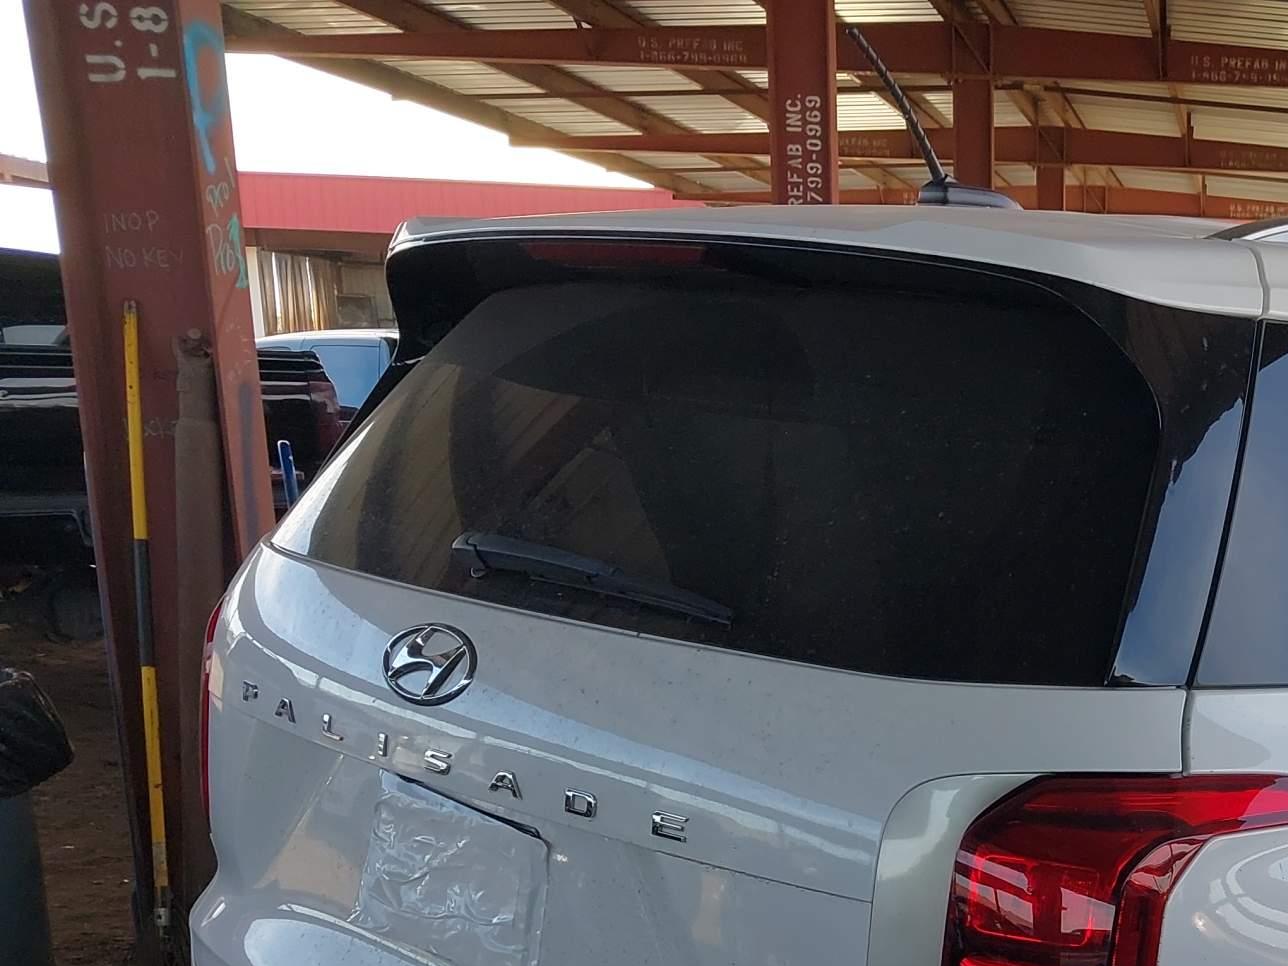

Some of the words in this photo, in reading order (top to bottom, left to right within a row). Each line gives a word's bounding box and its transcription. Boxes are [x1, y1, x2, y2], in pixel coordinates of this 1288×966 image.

[785, 93, 803, 133] INC.
[805, 95, 824, 202] 799-0969
[103, 208, 161, 234] INOP
[104, 245, 138, 270] NO
[242, 679, 690, 843] PALISADE
